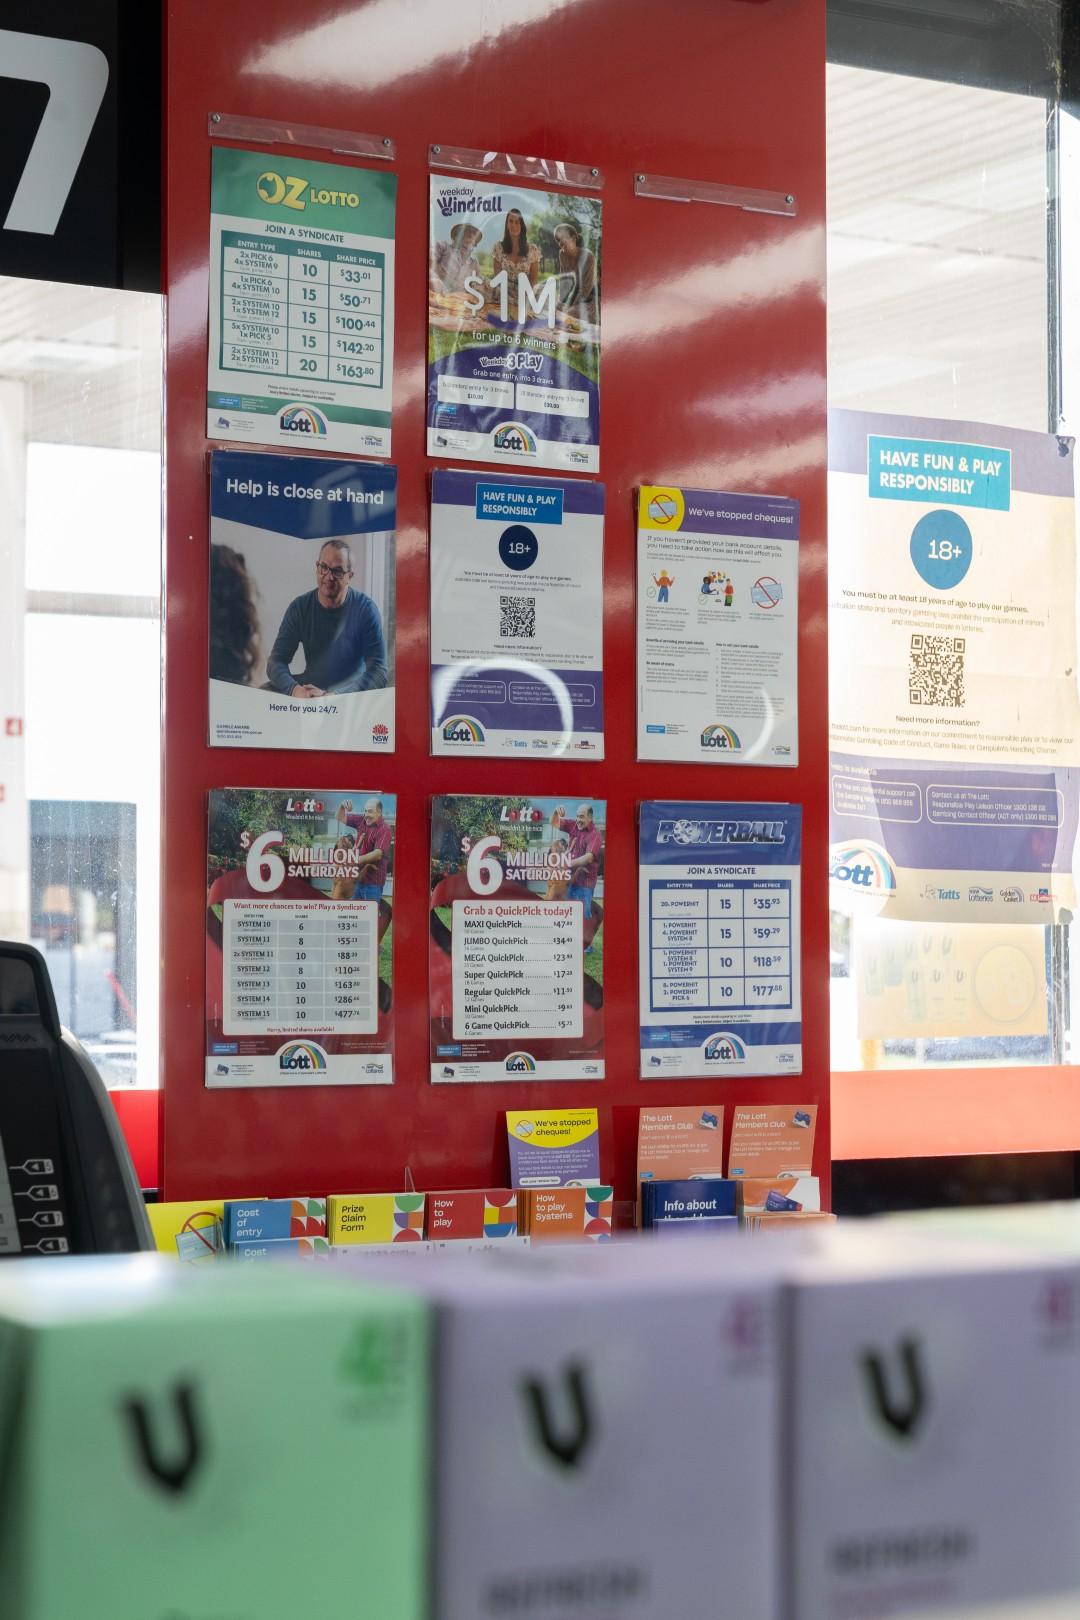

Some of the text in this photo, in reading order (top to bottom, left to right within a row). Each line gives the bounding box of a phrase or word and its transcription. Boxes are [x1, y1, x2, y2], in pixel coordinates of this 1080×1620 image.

[256, 171, 360, 210] OZ LOTTO
[440, 187, 473, 196] weekday
[265, 225, 344, 243] JOIN A SYNDICATE
[238, 241, 376, 266] ENTRY TYPE SHARES SHARE PRICE
[303, 264, 317, 277] 10
[302, 288, 316, 301] 15
[464, 270, 557, 329] $1M
[302, 312, 316, 324] 15
[302, 335, 316, 348] 15
[472, 331, 556, 350] for up to 6 winners
[300, 359, 317, 372] 20
[473, 369, 488, 377] Grab
[536, 376, 553, 385] draws
[880, 450, 1001, 476] HAVE FUN & PLAY
[880, 472, 975, 494] RESPONSIBLY
[226, 478, 384, 505] Help is close at hand
[483, 491, 556, 505] HAVE FUN & PLAY
[483, 504, 537, 516] RESPONSIBLY
[688, 507, 793, 524] We've stopped cheques!
[508, 542, 532, 554] 18+
[928, 540, 962, 560] 18+
[928, 597, 946, 605] years
[977, 602, 990, 610] play
[1004, 605, 1028, 613] games.
[269, 704, 339, 714] Here for you 24/7.
[895, 715, 915, 724] Need
[935, 717, 981, 727] information?
[286, 798, 325, 813] Lotto
[501, 806, 545, 822] Lotto
[656, 820, 786, 844] POWERBALL
[289, 848, 360, 864] MILLION
[506, 852, 572, 868] MILLION
[288, 865, 359, 878] SATURDAYS
[506, 869, 572, 881] SATURDAYS
[937, 888, 960, 900] Tatts
[318, 903, 331, 911] Play
[720, 899, 731, 909] 15
[464, 906, 572, 918] Grab a QuickPick today!
[485, 920, 522, 929] QuickPick
[720, 928, 732, 939] 15
[492, 937, 528, 946] QuickPick
[464, 954, 524, 963] MEGA QuickPick
[464, 971, 523, 980] Super QuickPick
[464, 988, 530, 997] Regular QuickPick
[560, 1118, 591, 1126] stopped
[641, 1122, 693, 1131] Members Club
[735, 1120, 786, 1129] Members Club
[434, 1200, 454, 1208] How
[536, 1194, 555, 1202] How
[342, 1205, 364, 1214] Prize
[548, 1203, 565, 1212] play
[664, 1199, 716, 1211] Info about
[237, 1209, 260, 1217] Cost
[341, 1214, 366, 1223] Claim
[434, 1209, 443, 1217] to
[536, 1212, 573, 1222] Systems
[237, 1218, 247, 1227] of
[341, 1224, 364, 1232] Form
[433, 1218, 452, 1228] play
[236, 1228, 262, 1237] entry
